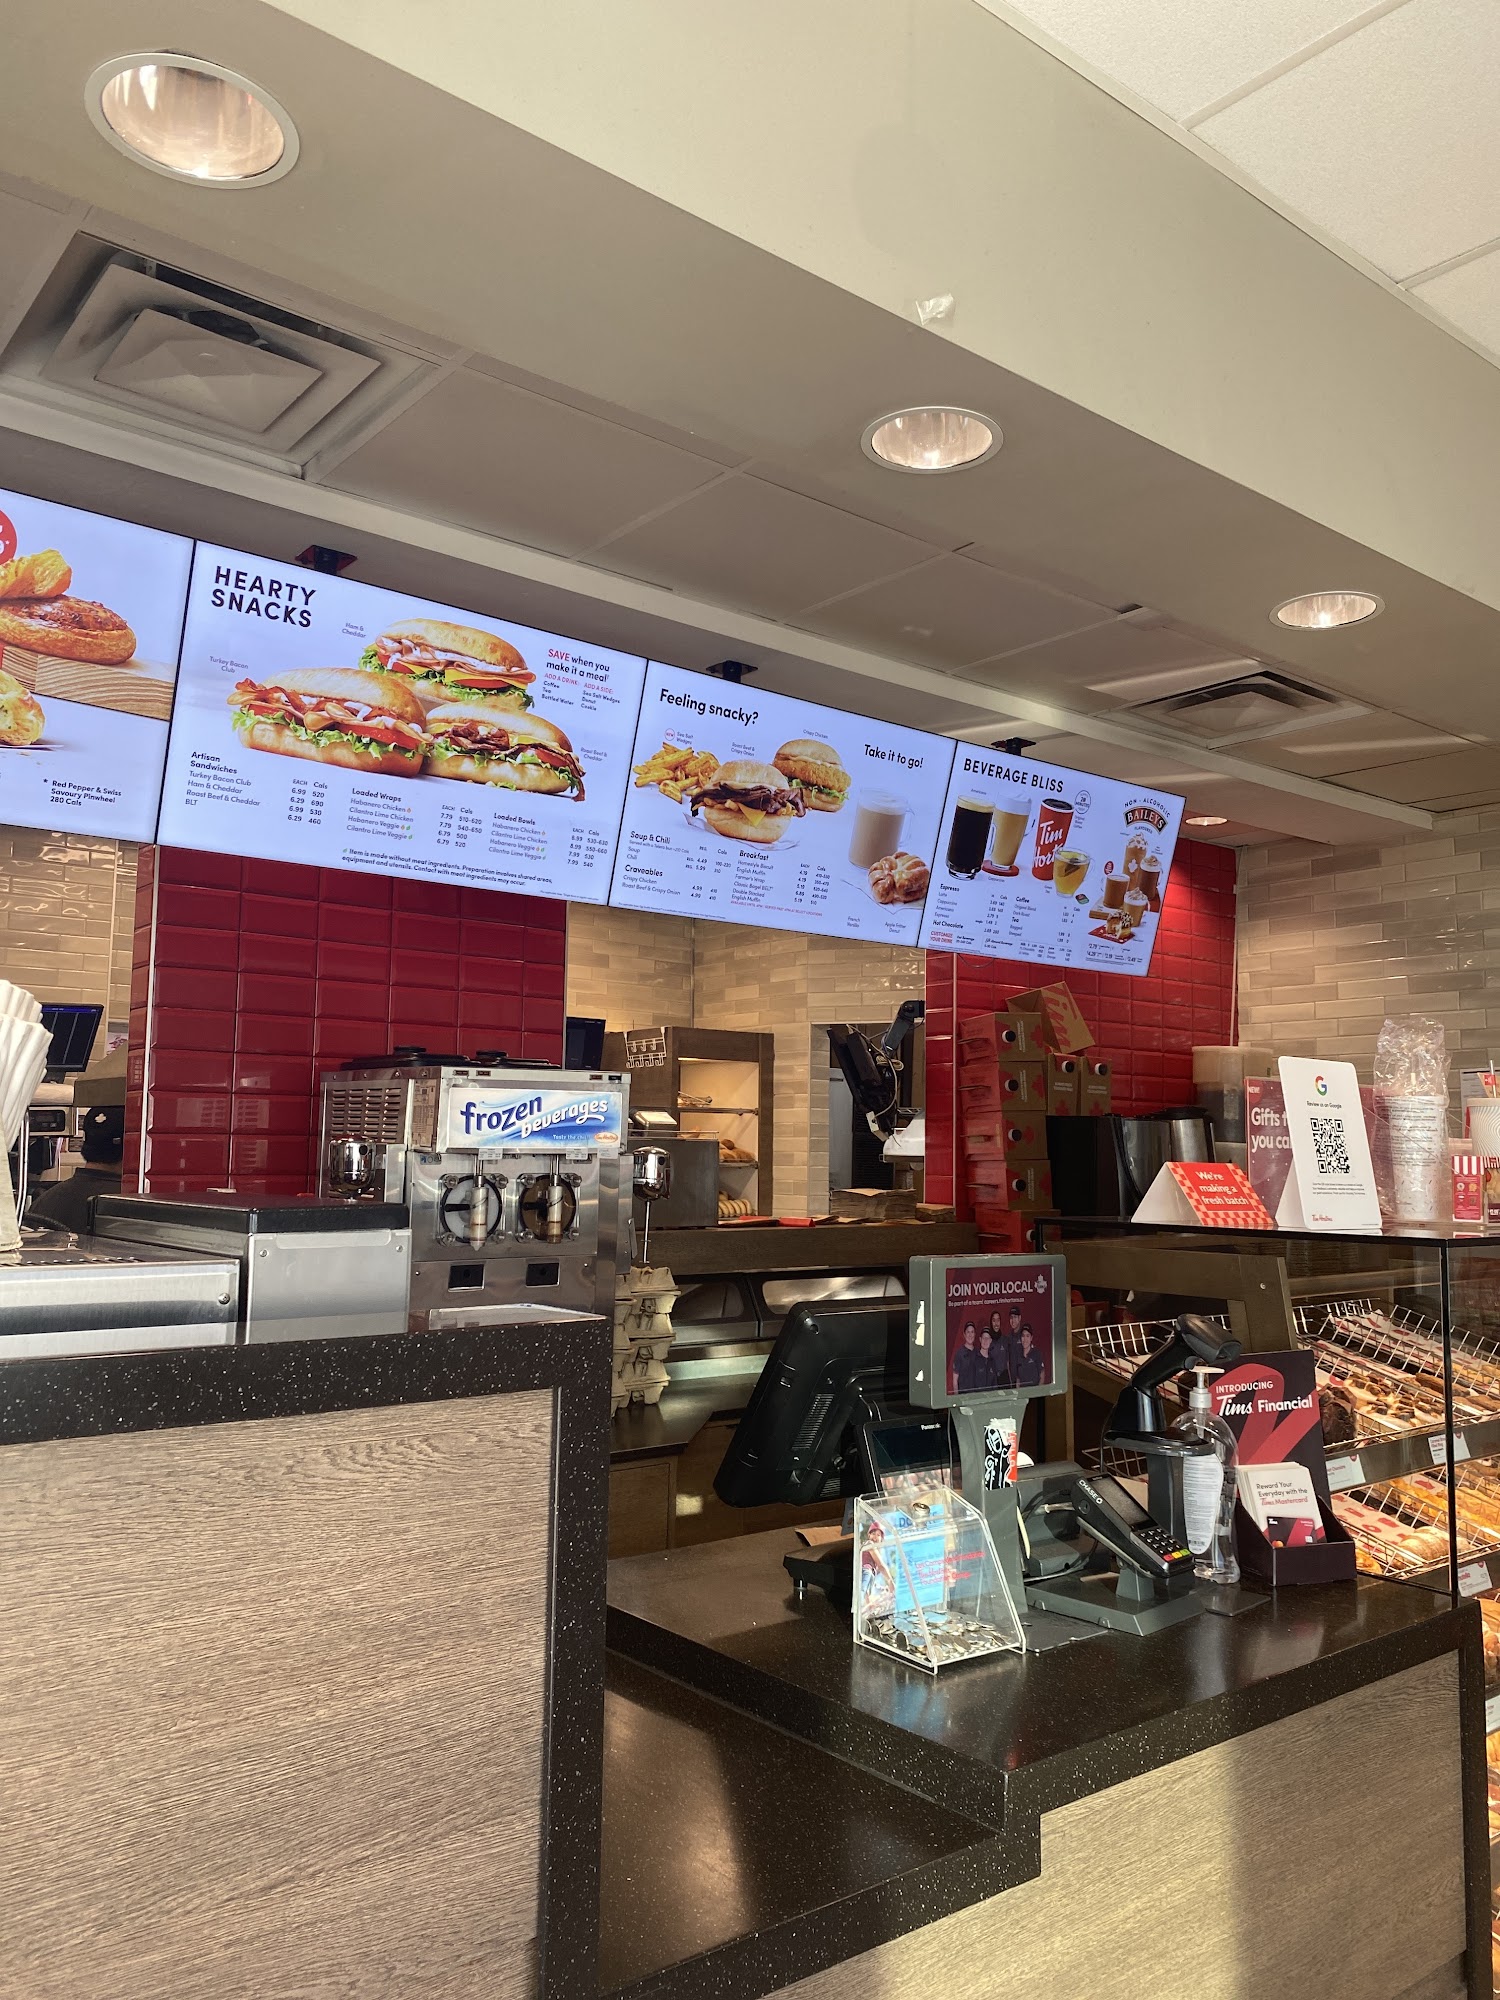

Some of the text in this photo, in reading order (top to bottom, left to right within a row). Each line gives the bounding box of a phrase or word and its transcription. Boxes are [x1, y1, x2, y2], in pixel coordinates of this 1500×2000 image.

[214, 565, 317, 606] HEARTY
[210, 588, 312, 628] SNACKS
[341, 628, 367, 638] Cheddar
[345, 622, 359, 631] Ham
[209, 656, 249, 669] Turkey Bacon
[548, 648, 610, 672] SAVE when you
[221, 665, 235, 673] Club
[546, 662, 570, 673] make
[571, 665, 578, 675] it
[543, 681, 560, 689] Coffee
[583, 682, 596, 690] ADD
[541, 694, 574, 706] Bottled Water
[602, 694, 621, 704] Wedges
[659, 688, 759, 727] Feeling snacky?
[191, 751, 220, 763] Artisan
[864, 743, 924, 769] Take it to go!
[190, 760, 238, 774] Sandwiches
[189, 770, 252, 786] Turkey Bacon Club
[963, 758, 1064, 793] BEVERAGE BLISS
[52, 780, 66, 788] Red
[68, 782, 95, 792] Pepper
[103, 788, 122, 796] Swiss
[187, 779, 204, 788] Ham
[212, 783, 243, 794] Cheddar
[291, 787, 306, 796] 6.99
[313, 781, 328, 790] Cals
[50, 796, 64, 804] 280
[51, 788, 116, 803] Savoury Pinwheel
[185, 798, 198, 806] BLT
[186, 789, 206, 798] Roast
[207, 792, 223, 800] Beef
[230, 796, 260, 807] Cheddar
[290, 796, 305, 804] 6.29
[352, 788, 402, 803] Loaded Wraps
[288, 805, 304, 813] 6.99
[350, 798, 406, 813] Habanero Chicken
[1124, 797, 1171, 818] NON ALCOHOLIC
[287, 814, 302, 822] 6.29
[349, 807, 414, 823] Cilantro Lime Chicken
[493, 812, 536, 825] Loaded Bowls
[1127, 809, 1165, 829] BAILEYS
[347, 815, 400, 830] Habanero Veggie
[492, 822, 541, 835] Habanero Chicken
[346, 824, 408, 840] Cilantro Lime Veggie
[491, 830, 513, 839] Cilantro
[526, 836, 548, 844] Chicken
[630, 830, 648, 841] Soup
[655, 835, 671, 844] Chili
[1040, 820, 1064, 846] Tim
[739, 849, 769, 861] Breakfast
[341, 856, 376, 865] equipment
[413, 865, 437, 874] Contact
[466, 872, 497, 883] ingredients
[625, 864, 663, 877] Craveables
[940, 883, 960, 892] Espresso
[941, 920, 964, 929] Chocolate
[460, 1096, 543, 1135] frozen
[521, 1099, 609, 1139] beverages
[1251, 1107, 1280, 1127] Gifts
[1251, 1134, 1274, 1153] you
[1195, 1171, 1224, 1181] We're
[1199, 1184, 1233, 1195] making
[1201, 1196, 1249, 1205] fresh batch
[948, 1280, 1034, 1298] JOIN YOUR LOCAL
[953, 1300, 964, 1308] part
[1215, 1380, 1274, 1394] INTRODUCING
[1216, 1393, 1313, 1417] Tims Financial
[1078, 1479, 1098, 1500] CHASE
[1258, 1489, 1285, 1498] Everyday
[1274, 1496, 1309, 1505] Mastercard
